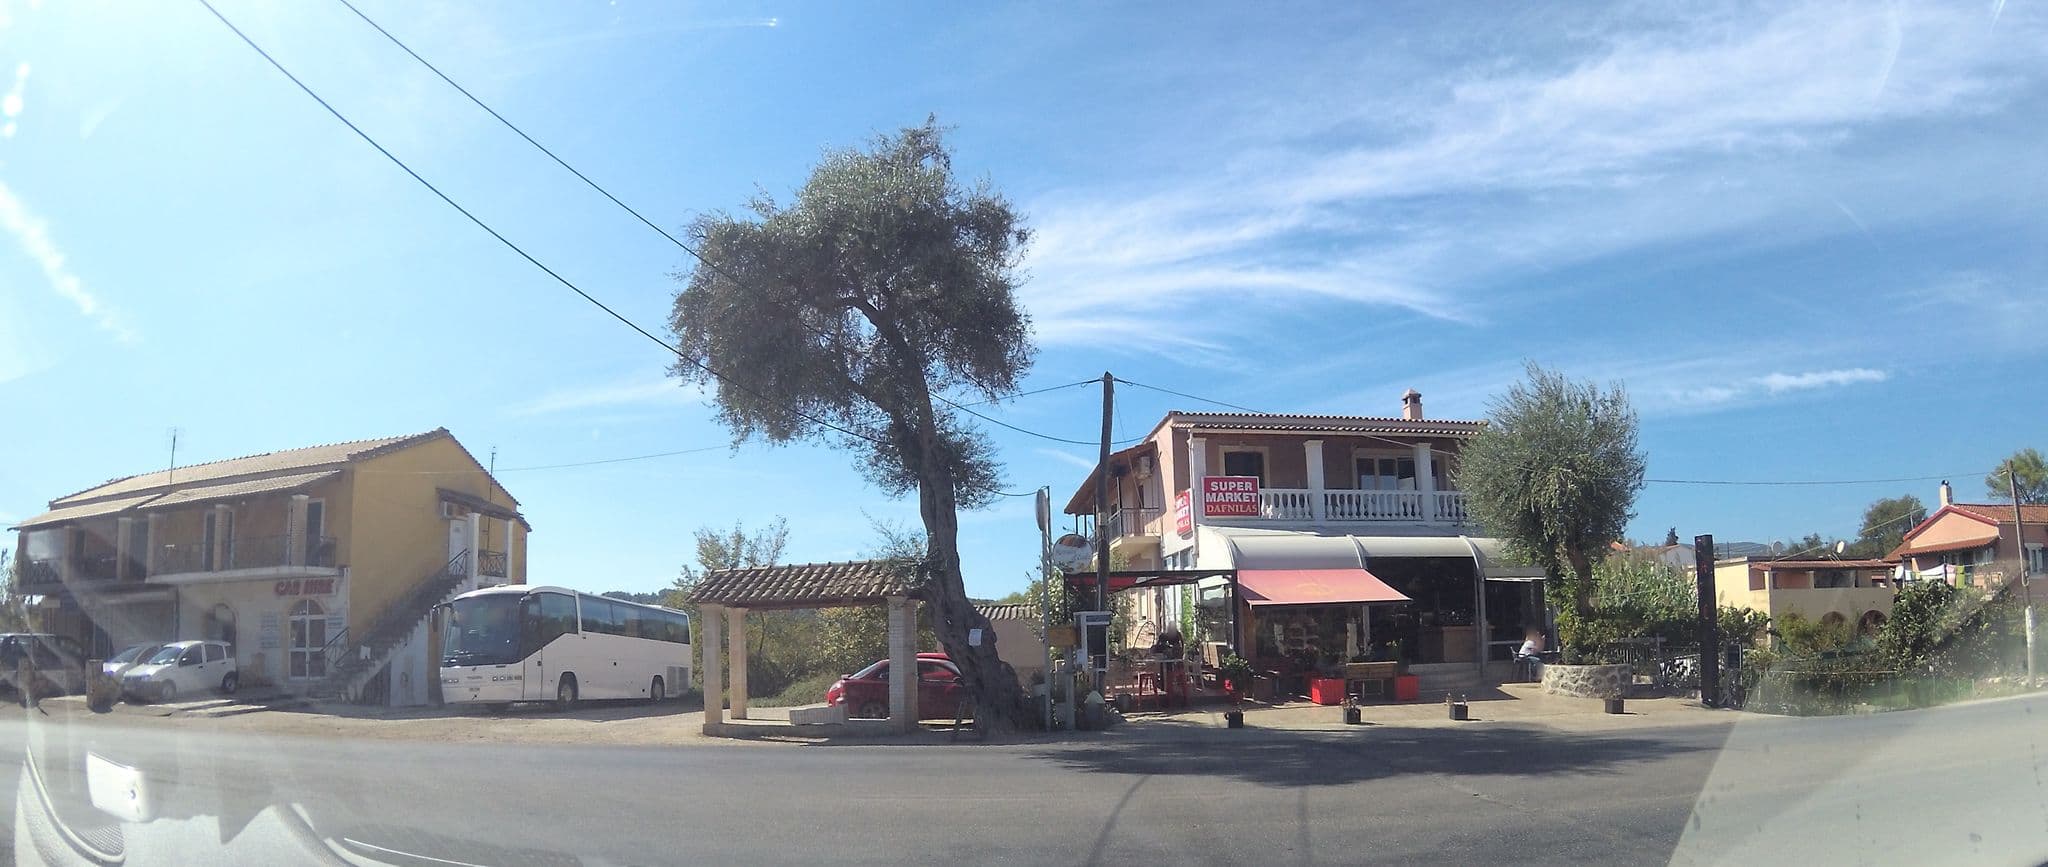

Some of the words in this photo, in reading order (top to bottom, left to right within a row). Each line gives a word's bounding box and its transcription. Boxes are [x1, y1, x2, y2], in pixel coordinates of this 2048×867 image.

[1211, 481, 1252, 491] SUPER
[1206, 493, 1257, 502] MARKET
[1207, 505, 1257, 513] DAFNILAS
